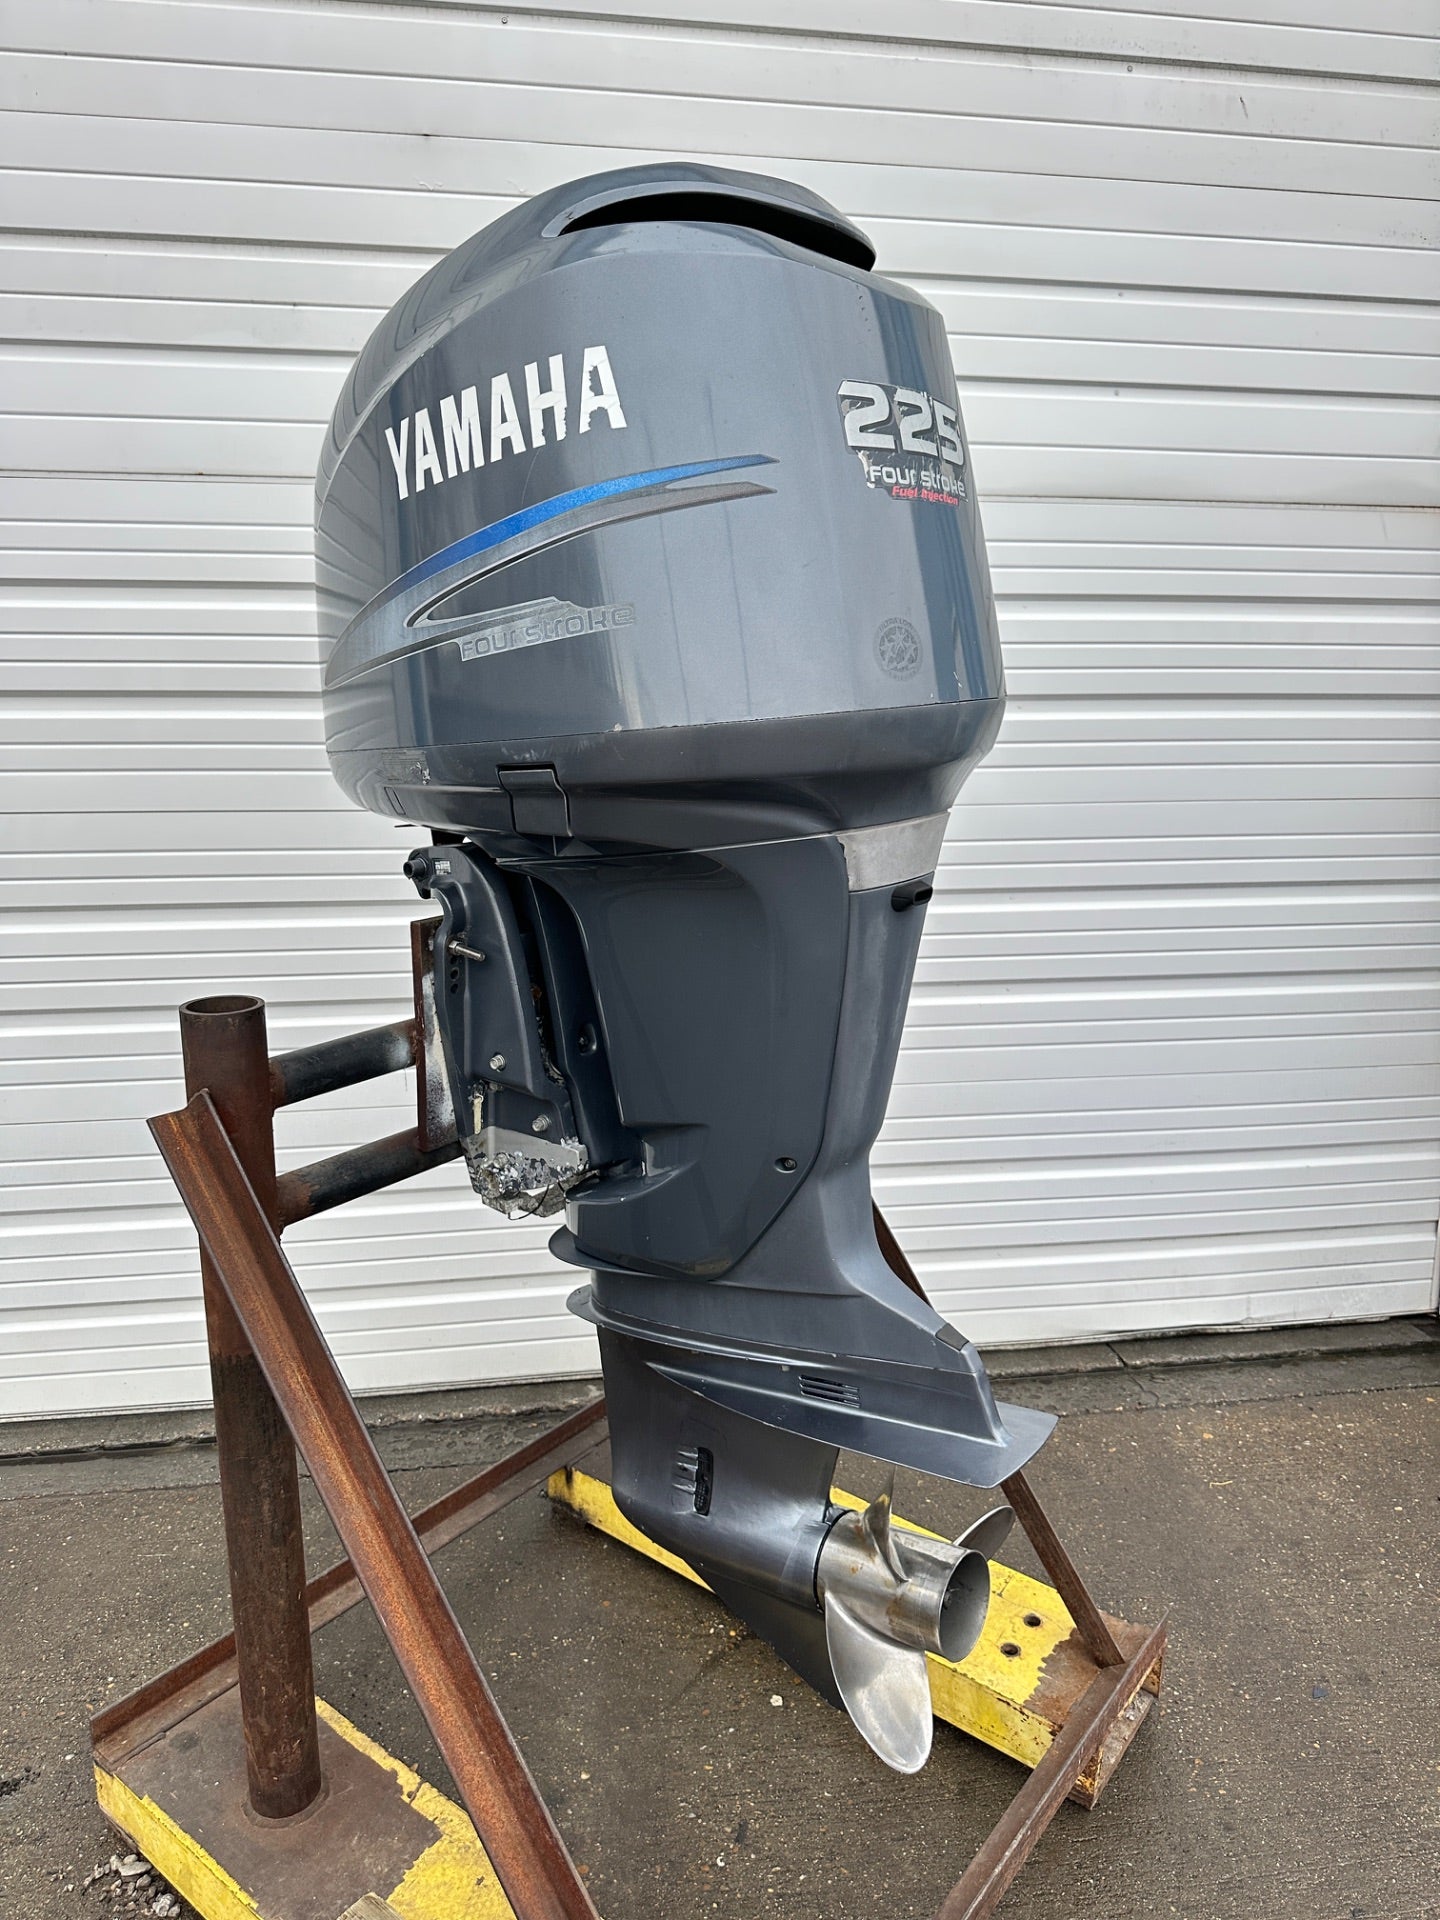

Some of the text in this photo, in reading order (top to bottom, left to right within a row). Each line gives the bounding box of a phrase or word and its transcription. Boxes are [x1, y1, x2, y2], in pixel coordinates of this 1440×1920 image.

[385, 345, 628, 500] YAMAHA
[838, 381, 964, 465] 225
[892, 485, 959, 505] Fuel Injection
